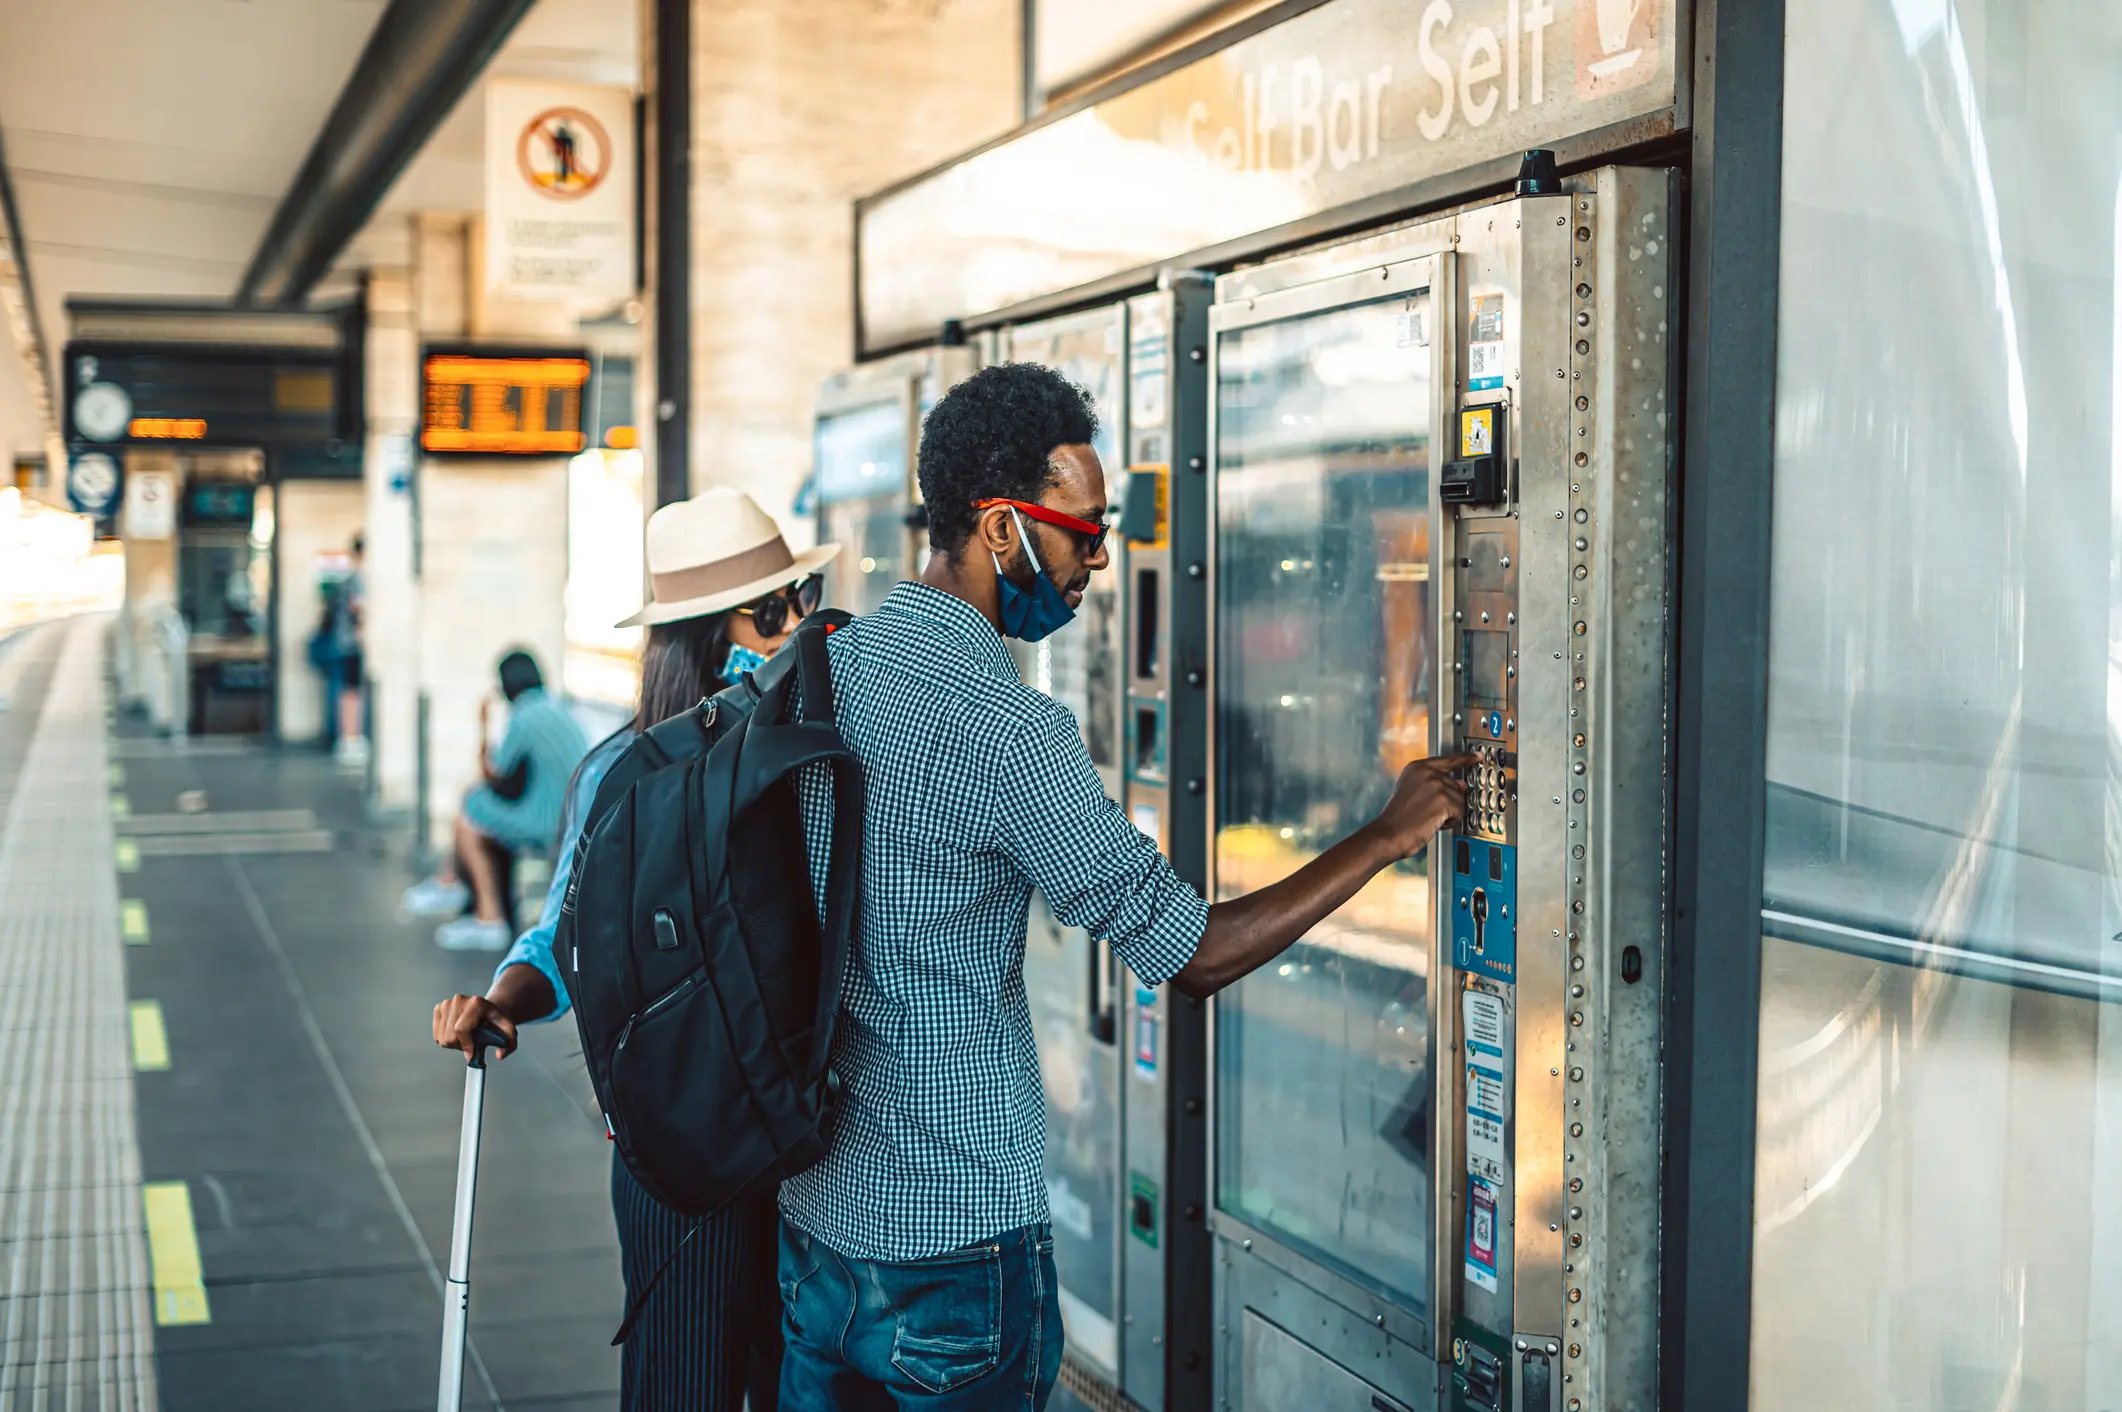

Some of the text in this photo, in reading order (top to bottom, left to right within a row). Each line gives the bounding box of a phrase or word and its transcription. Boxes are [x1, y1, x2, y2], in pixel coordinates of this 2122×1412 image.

[1292, 54, 1394, 176] Bar
[1416, 0, 1554, 141] Self
[1492, 715, 1499, 734] 2
[1456, 1339, 1463, 1363] 3
